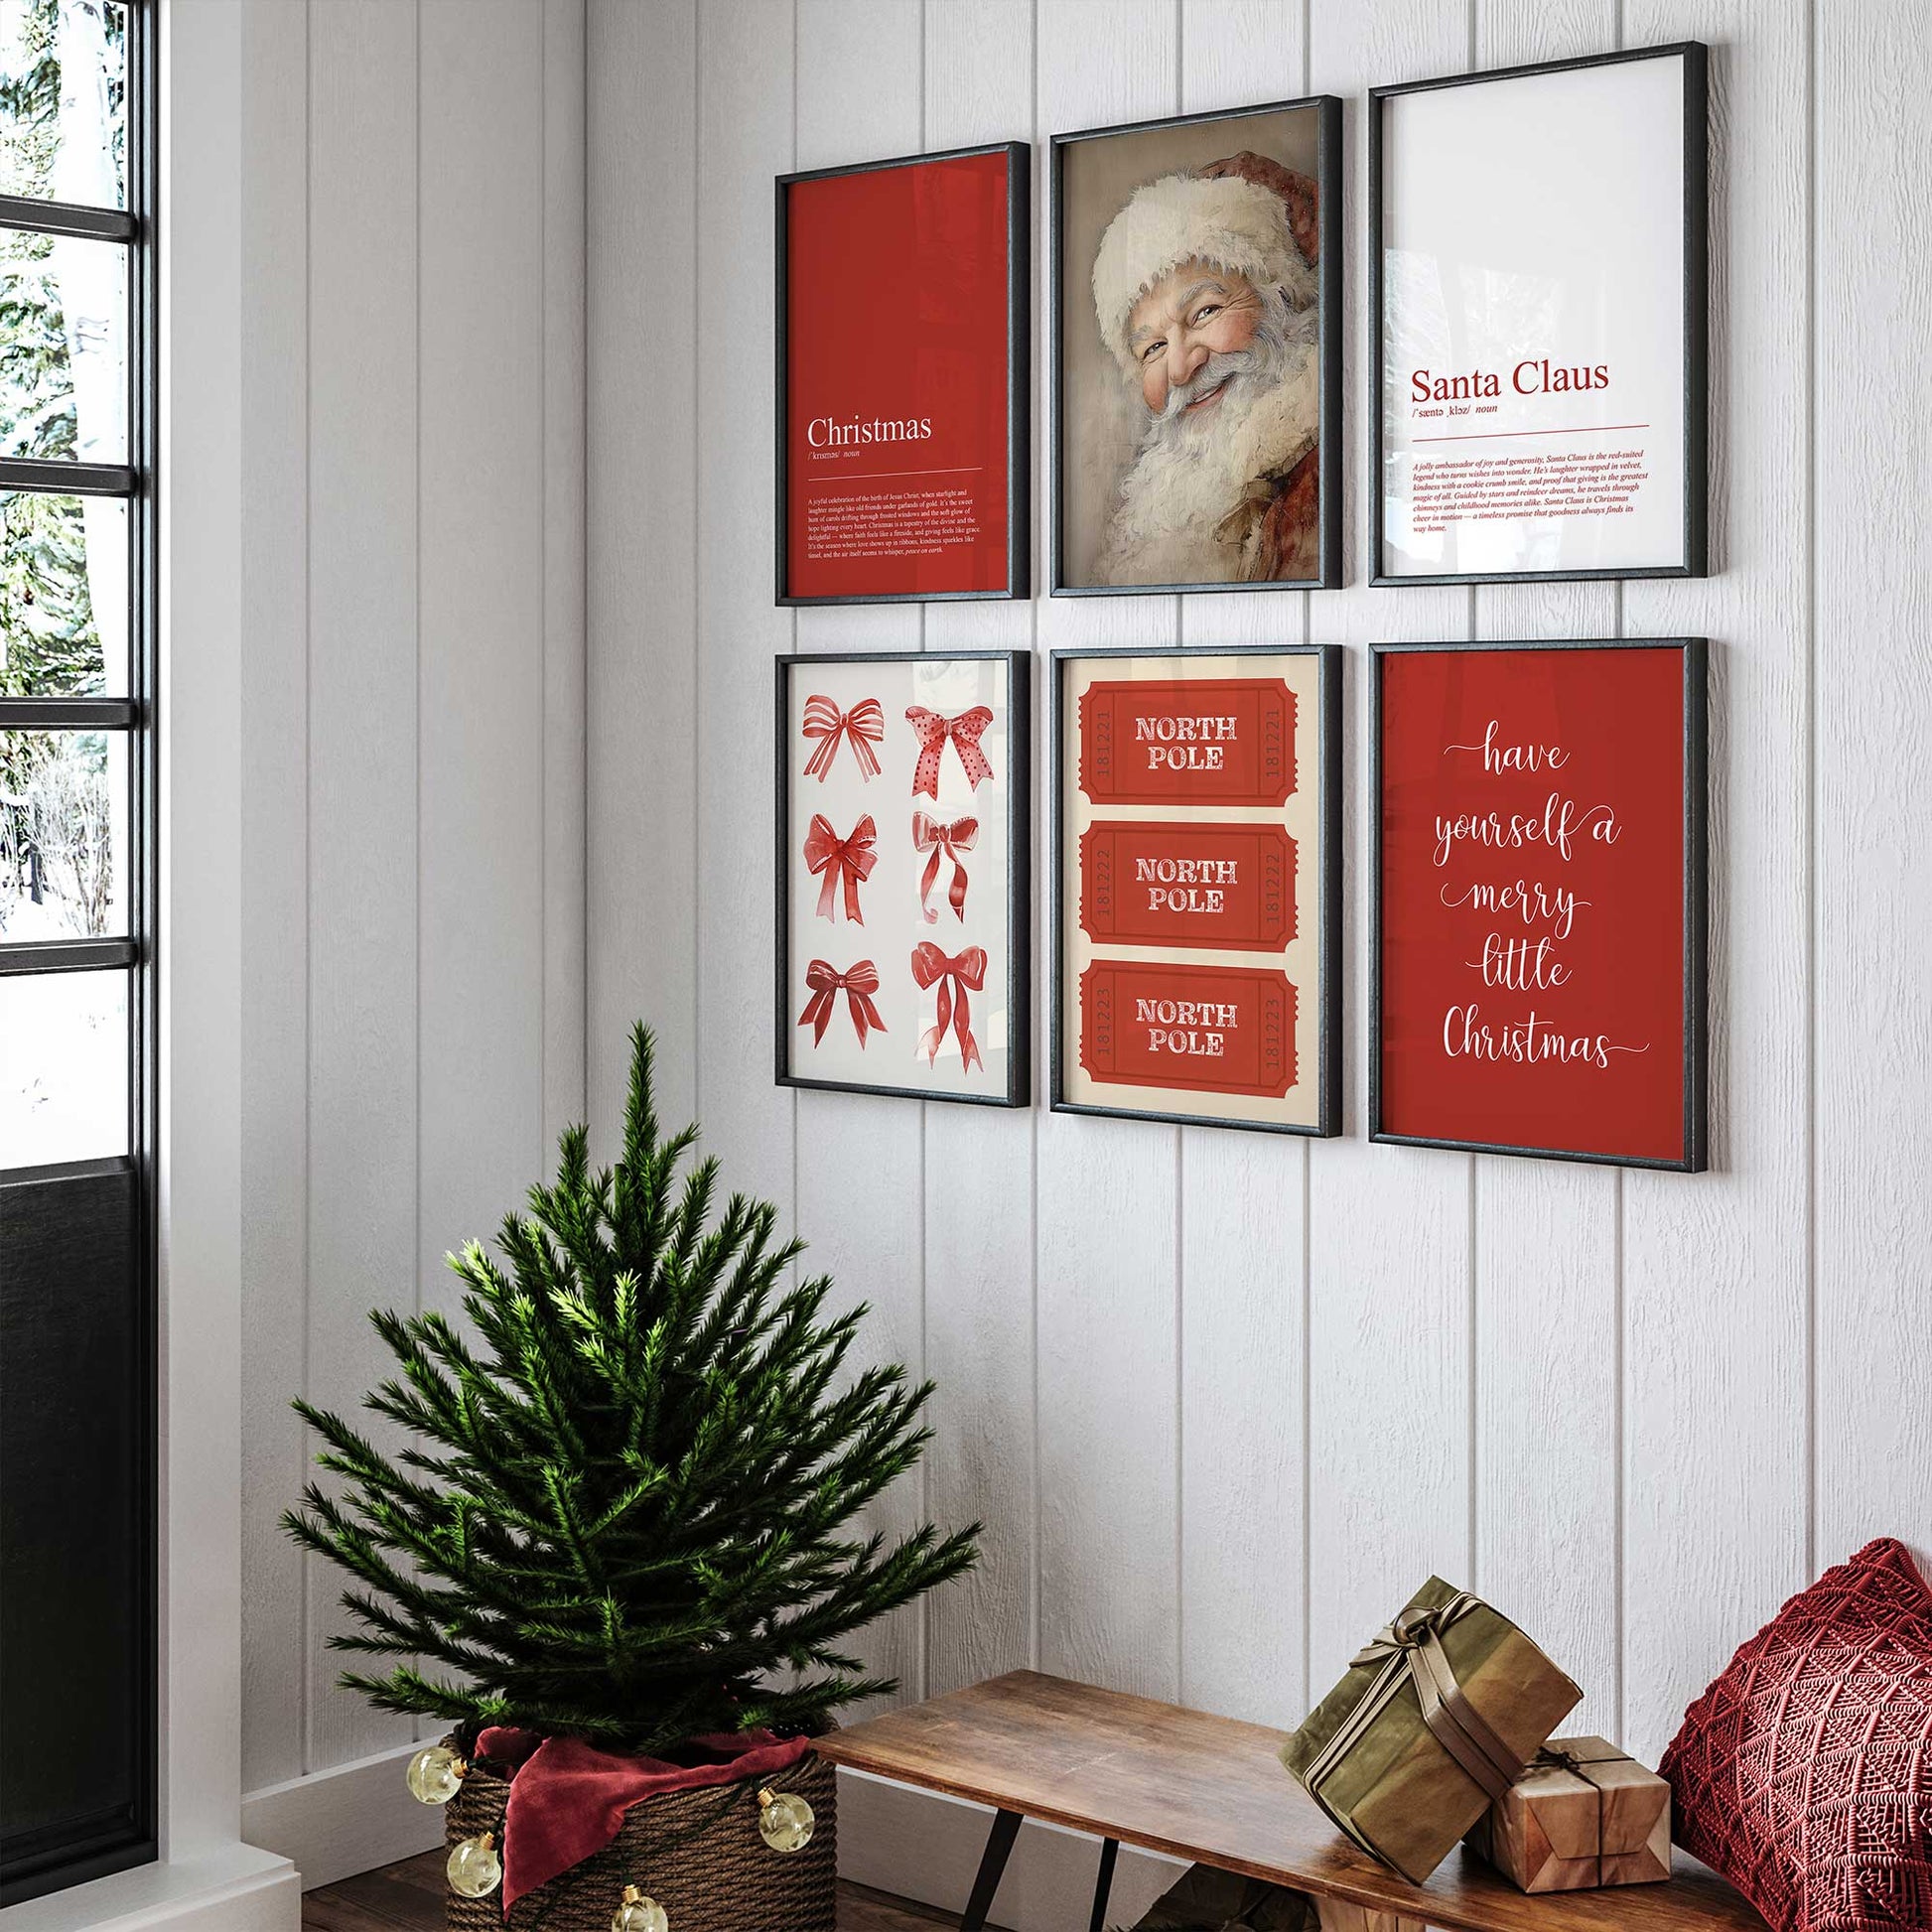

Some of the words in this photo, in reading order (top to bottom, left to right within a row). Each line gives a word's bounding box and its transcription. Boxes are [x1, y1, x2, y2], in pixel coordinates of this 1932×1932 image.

[1411, 369, 1502, 403] Santa
[1512, 359, 1609, 395] Claus
[807, 414, 932, 447] Christmas
[1413, 473, 1435, 483] legend
[1549, 465, 1578, 475] laughter
[1580, 463, 1610, 474] wrapped
[1419, 462, 1434, 472] jolly
[1435, 460, 1474, 469] ambassador
[1483, 459, 1493, 468] joy
[1609, 450, 1643, 459] red-suited
[1413, 494, 1432, 503] magic
[1612, 483, 1639, 494] through
[1543, 476, 1563, 486] proof
[1577, 475, 1599, 485] giving
[1620, 472, 1648, 482] greatest
[1413, 503, 1442, 513] chimneys
[1594, 494, 1629, 503] Christmas
[1506, 510, 1532, 519] promise
[1549, 507, 1579, 518] goodness
[1581, 506, 1605, 516] always
[1606, 505, 1623, 515] finds
[1097, 710, 1111, 776] 181221
[1135, 718, 1238, 741] NORTH
[1266, 709, 1280, 777] 181221
[1148, 746, 1224, 770] POLE
[1444, 719, 1571, 775] have
[1433, 792, 1584, 867] yourself
[1591, 811, 1622, 845] a
[1097, 849, 1111, 916] 181222
[1135, 858, 1238, 885] NORTH
[1148, 888, 1224, 913] POLE
[1266, 853, 1280, 924] 181222
[1440, 879, 1592, 940] merry
[1465, 932, 1573, 991] little
[1097, 988, 1111, 1055] 181223
[1135, 999, 1238, 1029] NORTH
[1148, 1029, 1224, 1056] POLE
[1266, 998, 1280, 1069] 181223
[1443, 1003, 1650, 1069] Christmas
